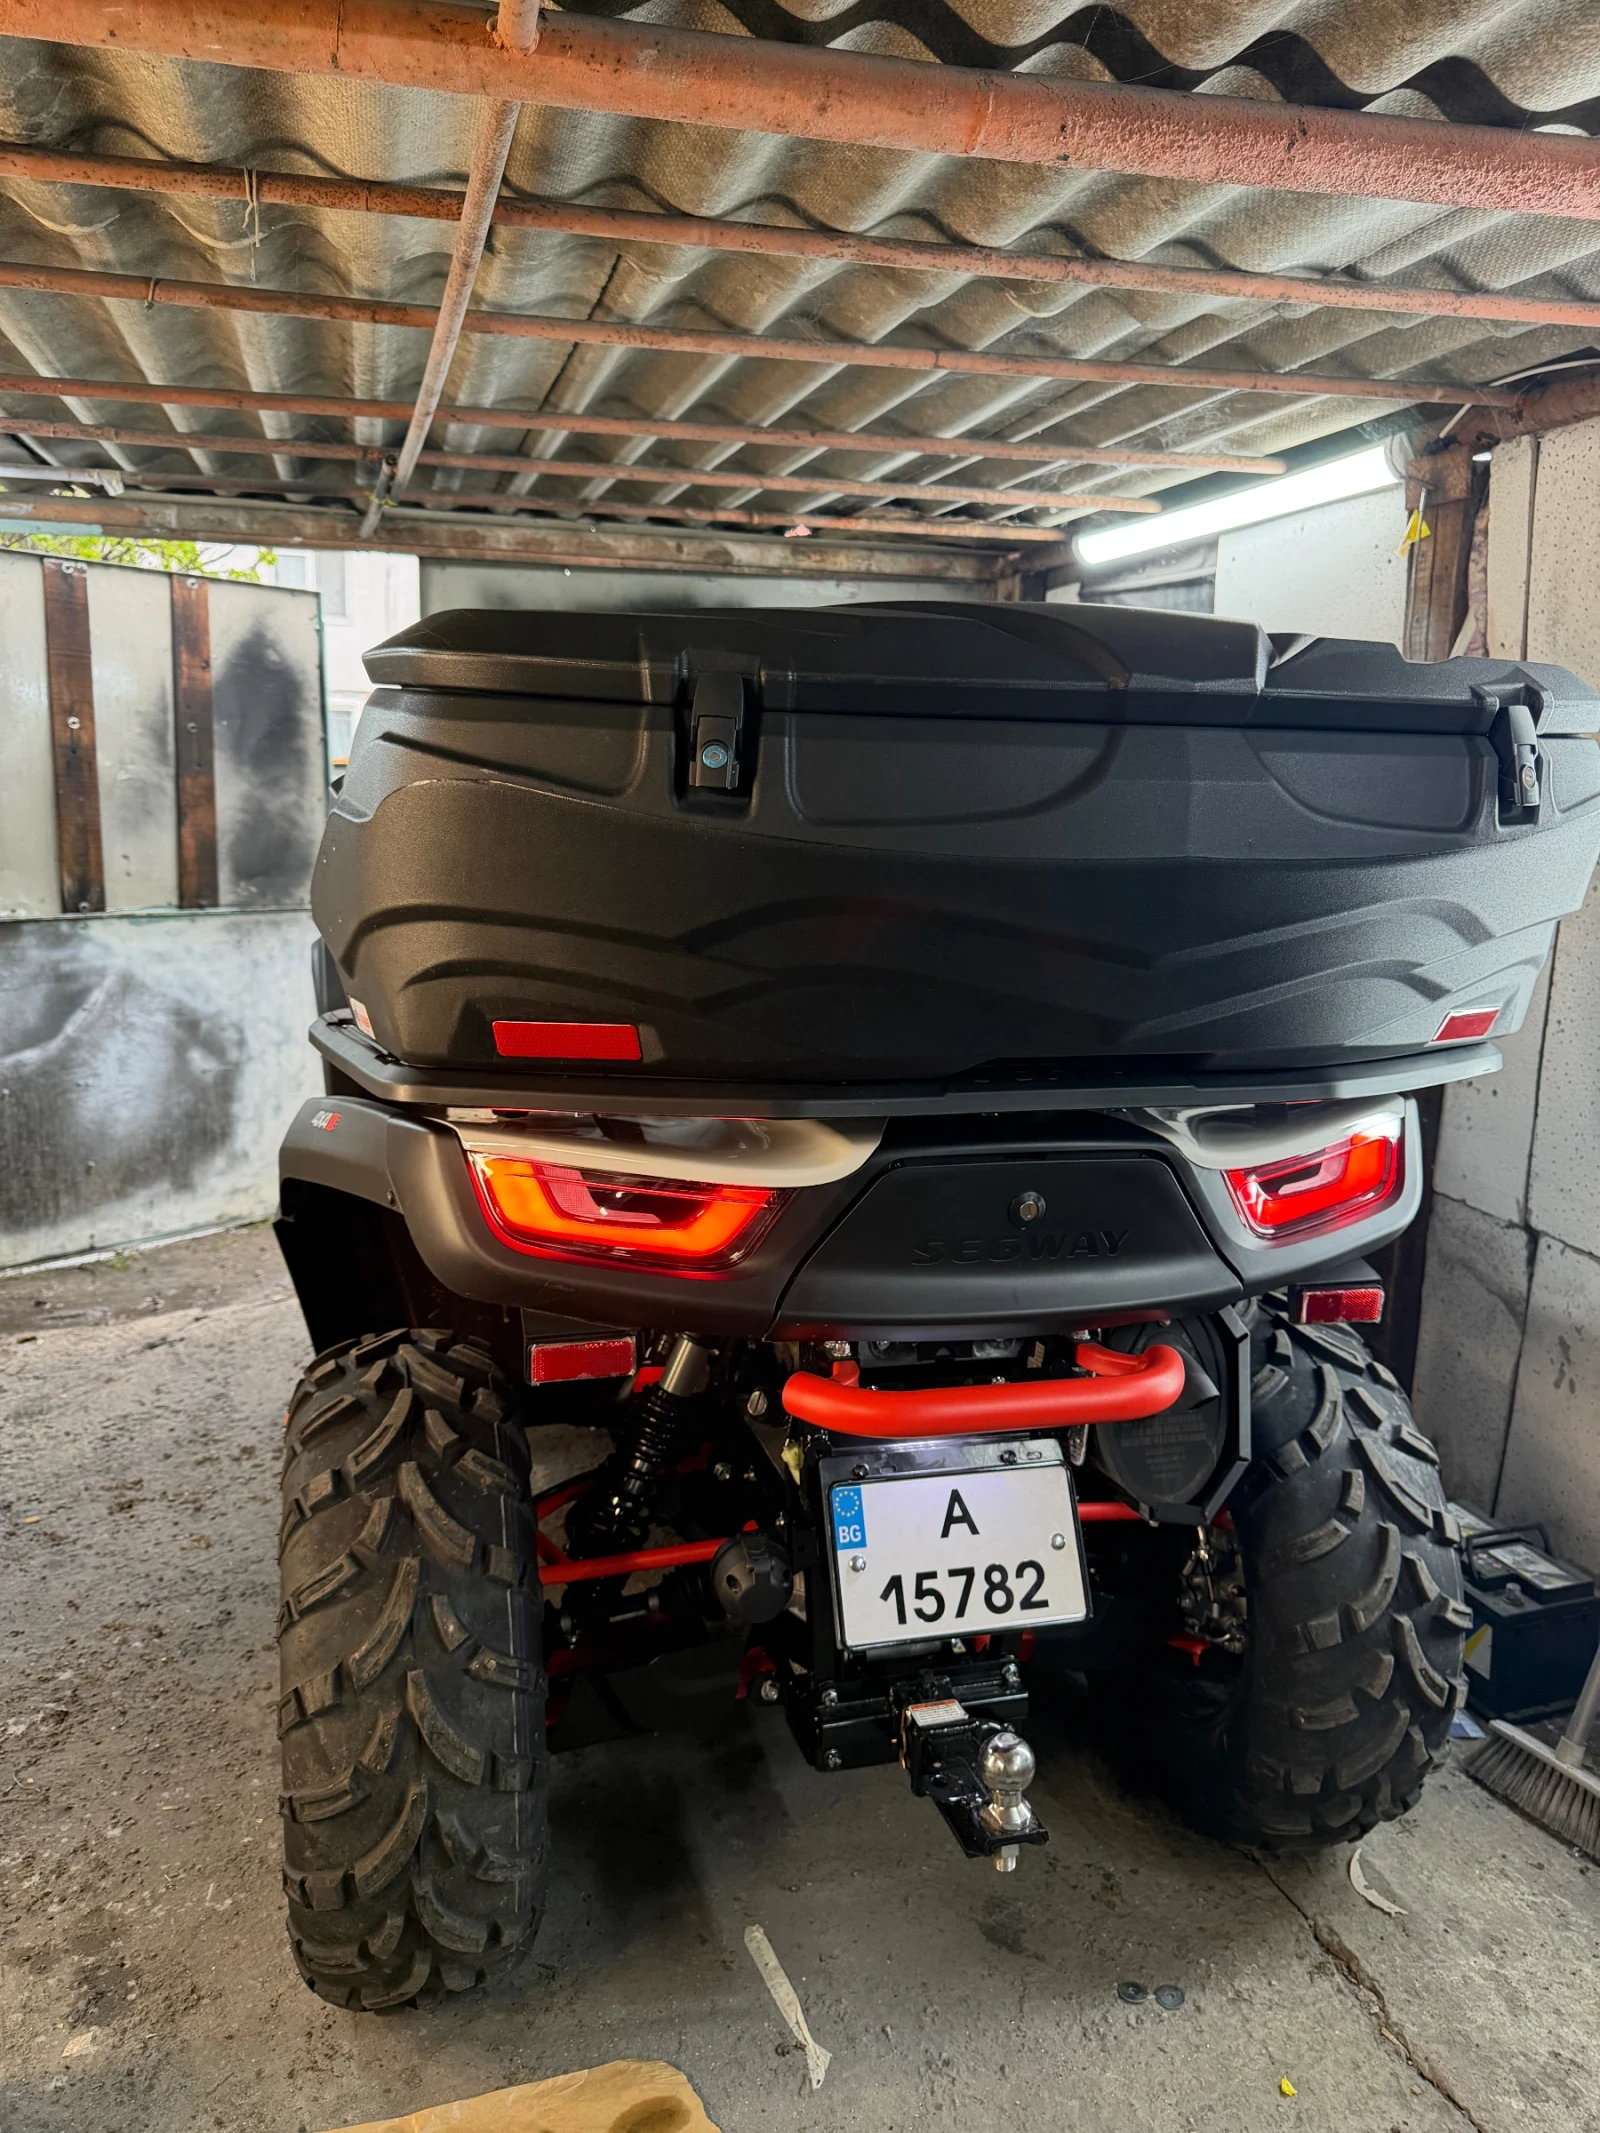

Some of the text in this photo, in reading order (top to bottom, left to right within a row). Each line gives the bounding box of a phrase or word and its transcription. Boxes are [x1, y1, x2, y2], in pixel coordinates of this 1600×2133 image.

[910, 1229, 1131, 1266] SEGWAY
[838, 1524, 862, 1544] BG
[940, 1488, 980, 1539] A
[879, 1559, 1050, 1625] 15782
